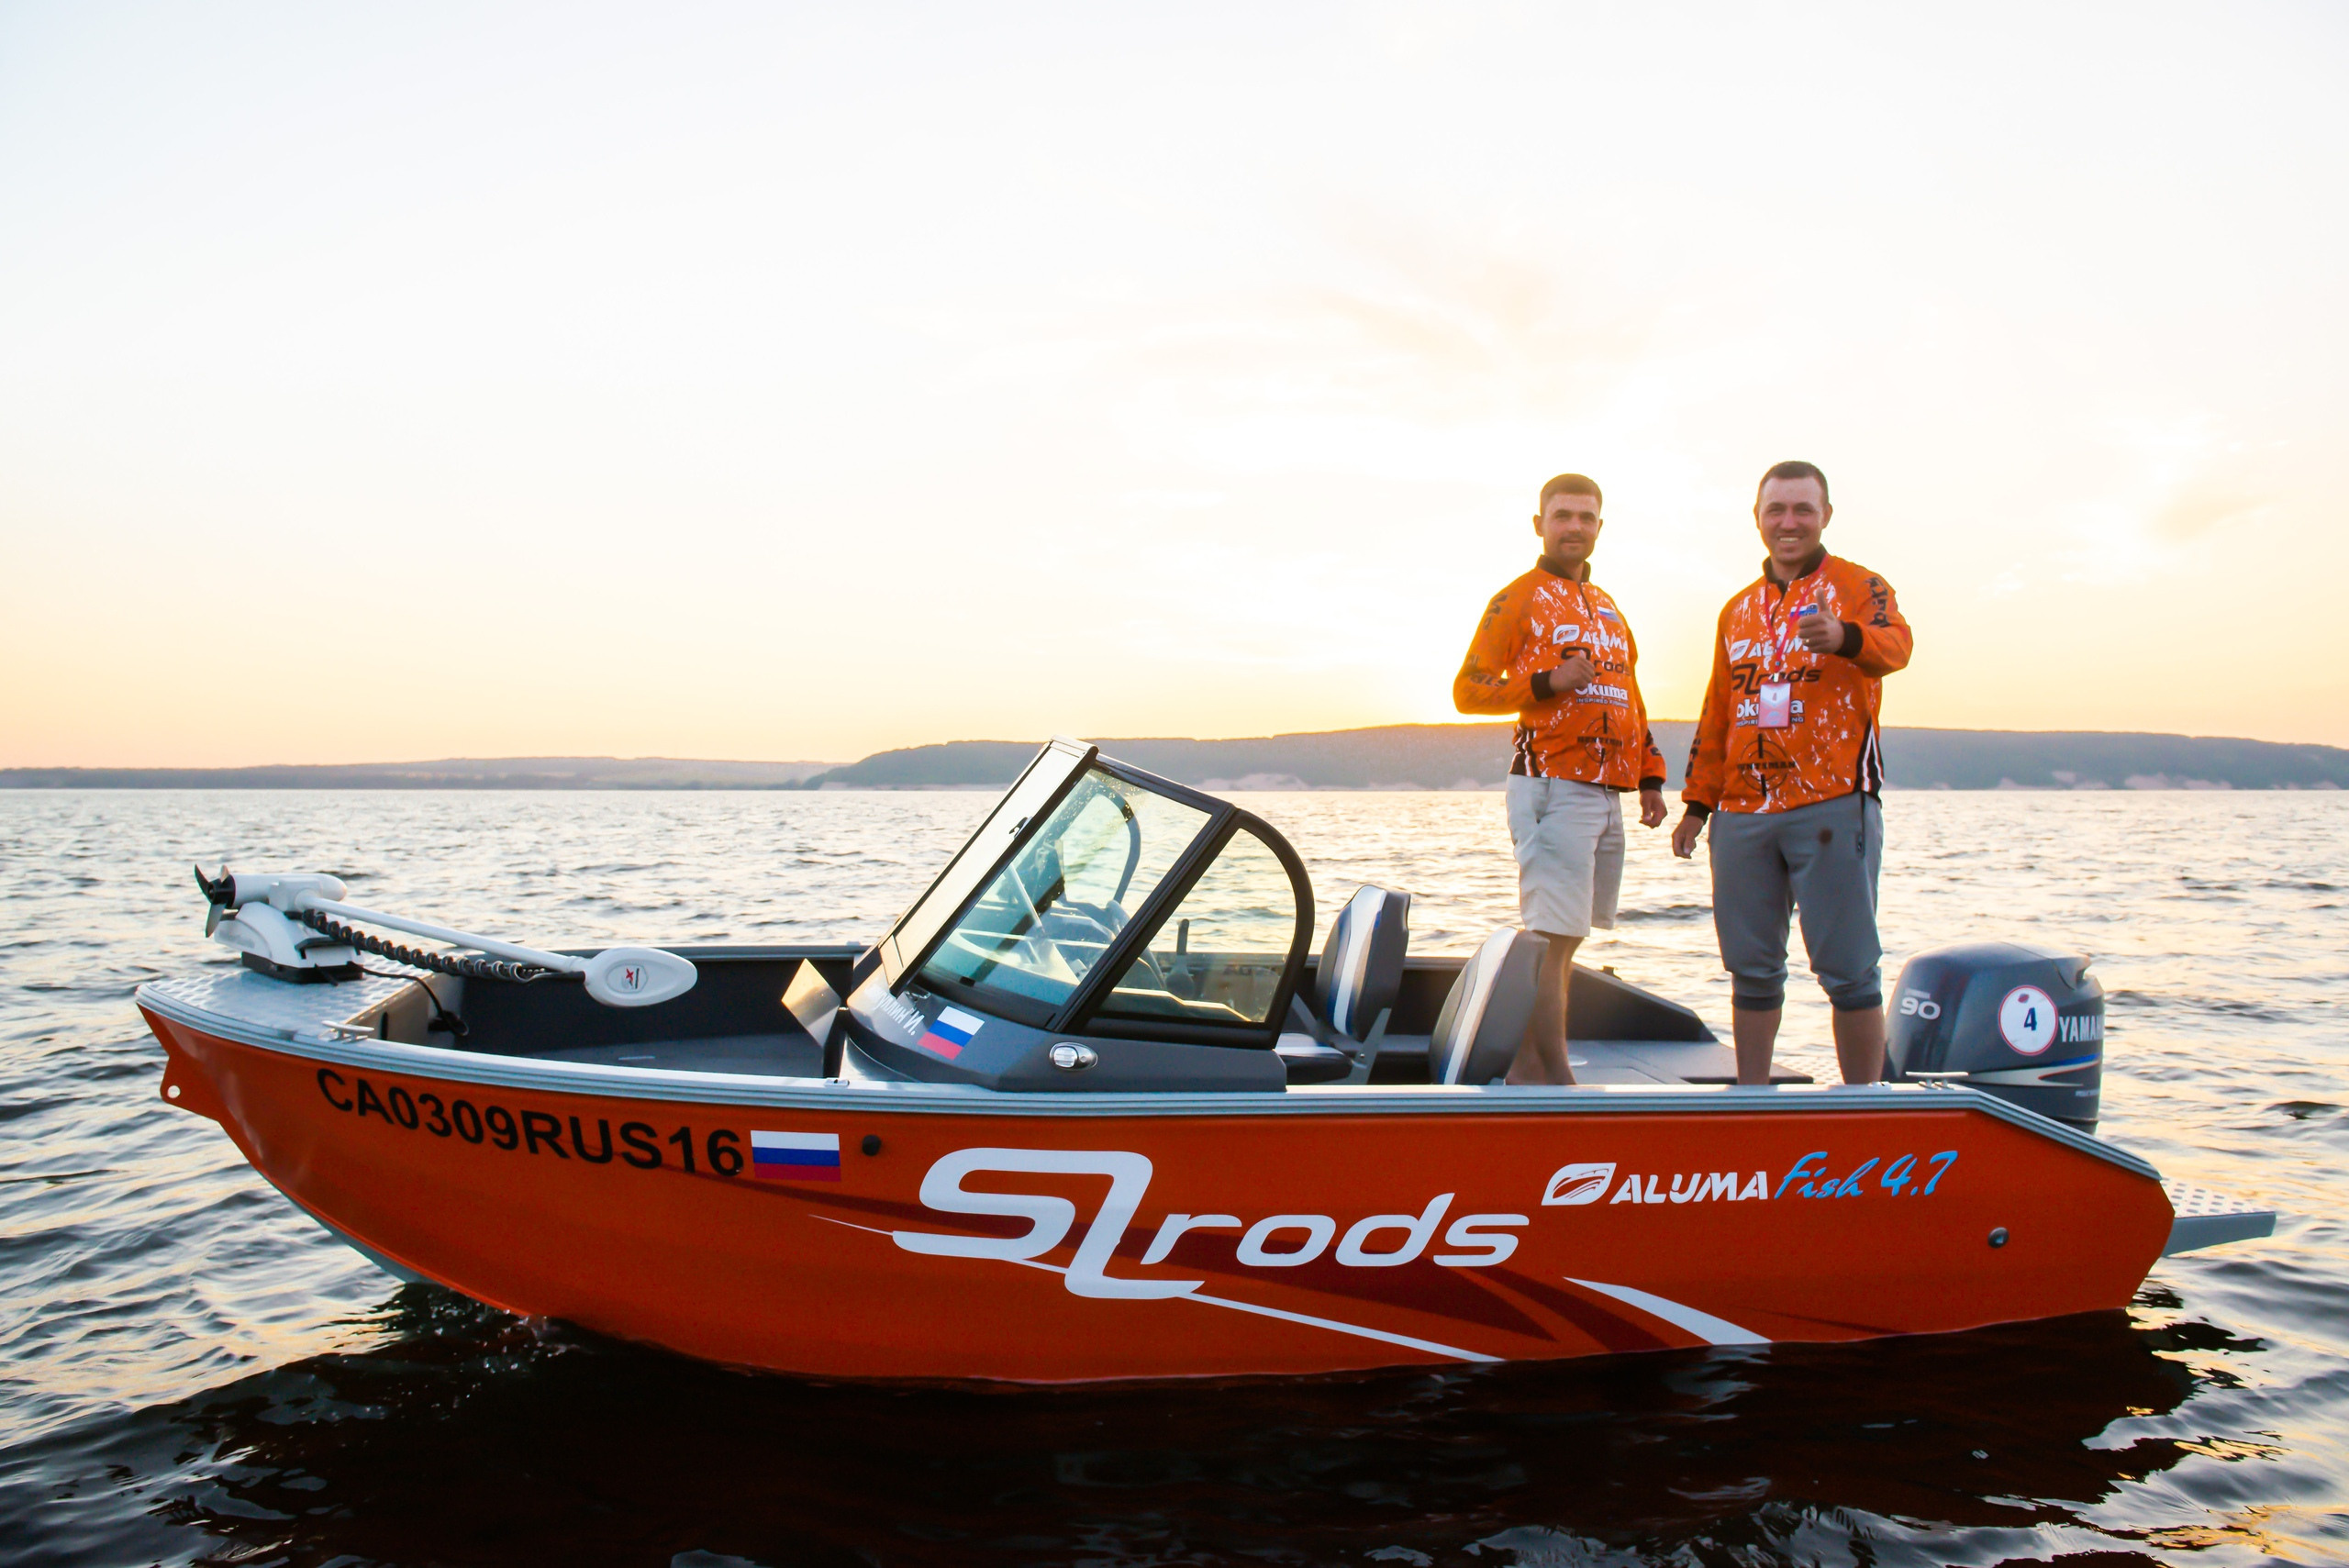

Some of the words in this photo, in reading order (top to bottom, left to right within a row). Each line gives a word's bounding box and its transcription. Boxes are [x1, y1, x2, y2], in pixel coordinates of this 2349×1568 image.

[1736, 698, 1804, 718] oka
[1899, 997, 1941, 1020] 90
[2023, 1006, 2037, 1031] 4
[317, 1067, 744, 1177] CA0309RUS16
[1609, 1171, 1768, 1205] ALUMA
[1775, 1151, 1881, 1199] Fish
[1881, 1150, 1958, 1196] 4.7
